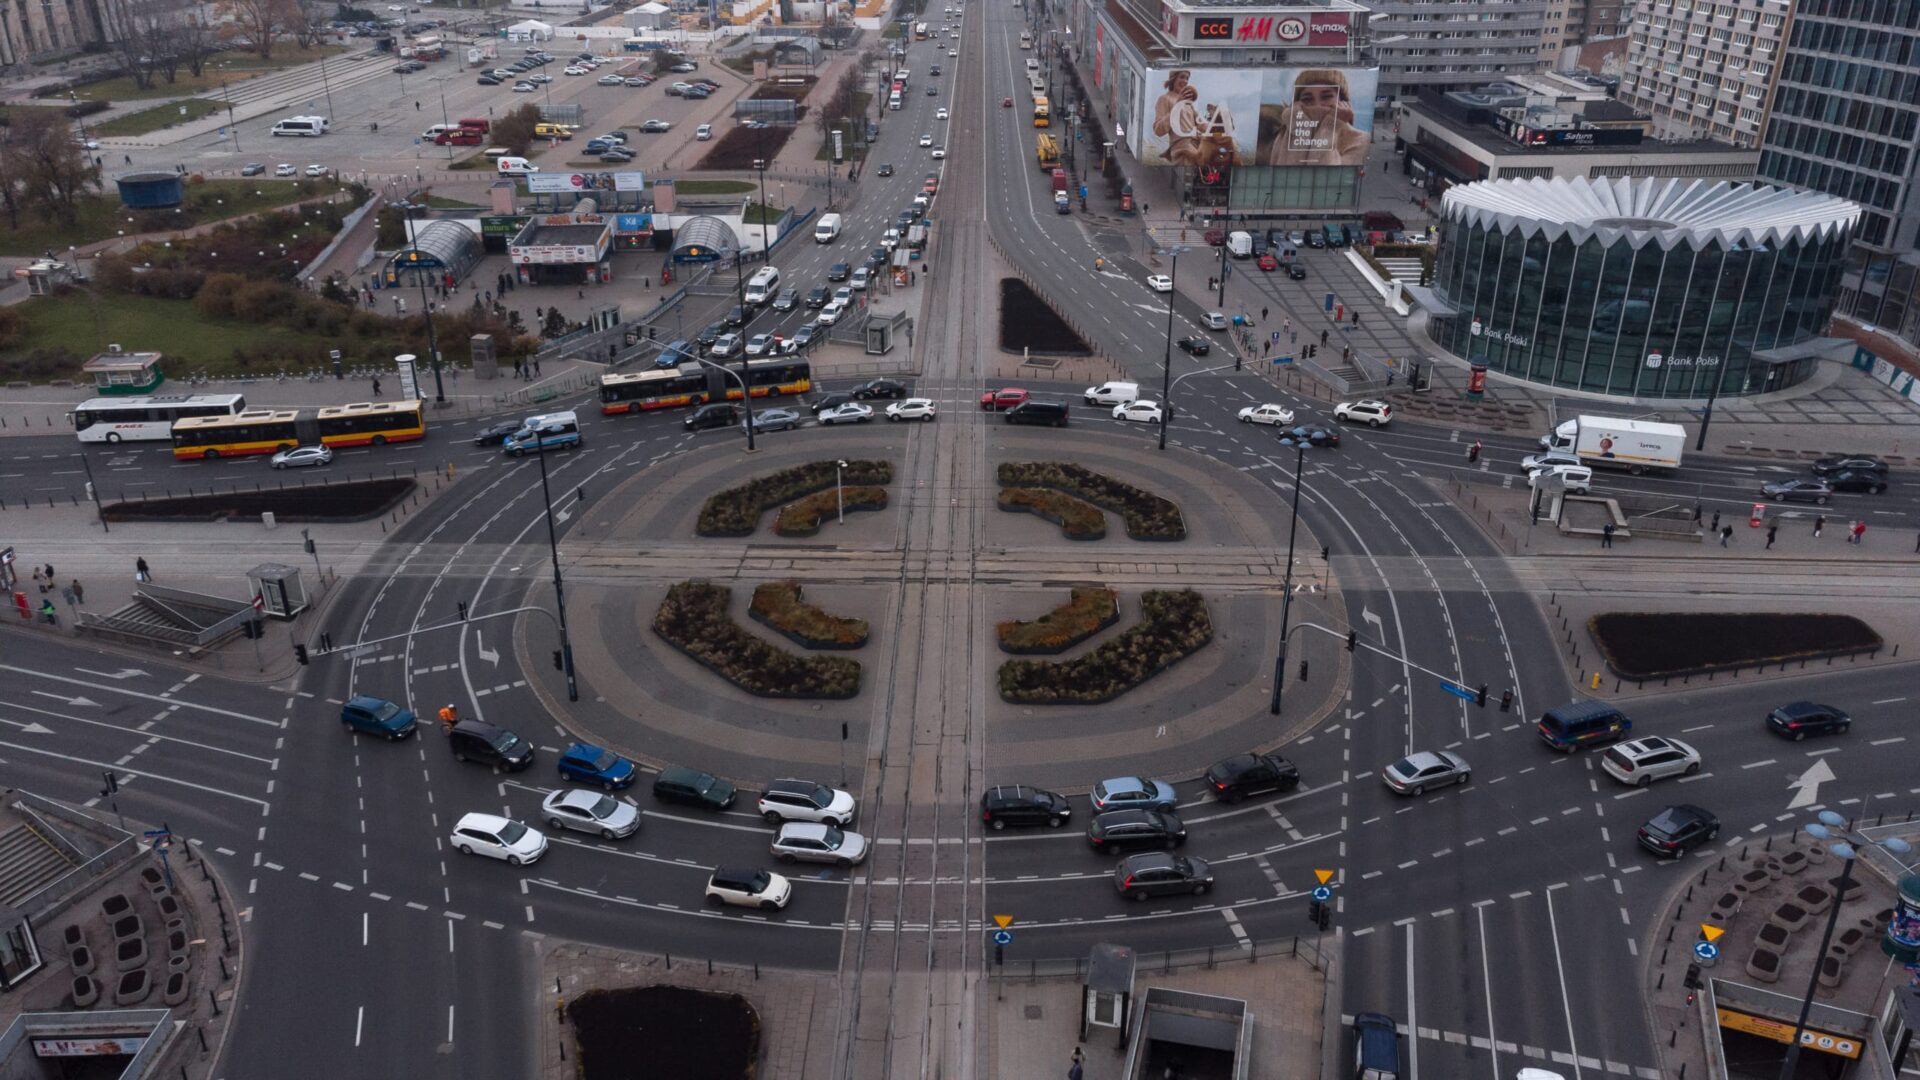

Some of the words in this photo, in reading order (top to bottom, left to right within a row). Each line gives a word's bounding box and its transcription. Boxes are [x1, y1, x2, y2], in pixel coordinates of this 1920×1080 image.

[1200, 23, 1228, 36] CCC
[1237, 17, 1273, 42] H&M
[1170, 100, 1234, 137] C&A
[1295, 120, 1320, 128] wear
[1294, 128, 1311, 137] the
[1564, 132, 1593, 141] Saturn
[1293, 137, 1329, 148] change
[1484, 326, 1502, 341] Bank
[1504, 332, 1528, 347] Polski
[1667, 355, 1692, 366] Bank
[1695, 355, 1721, 366] Polsk
